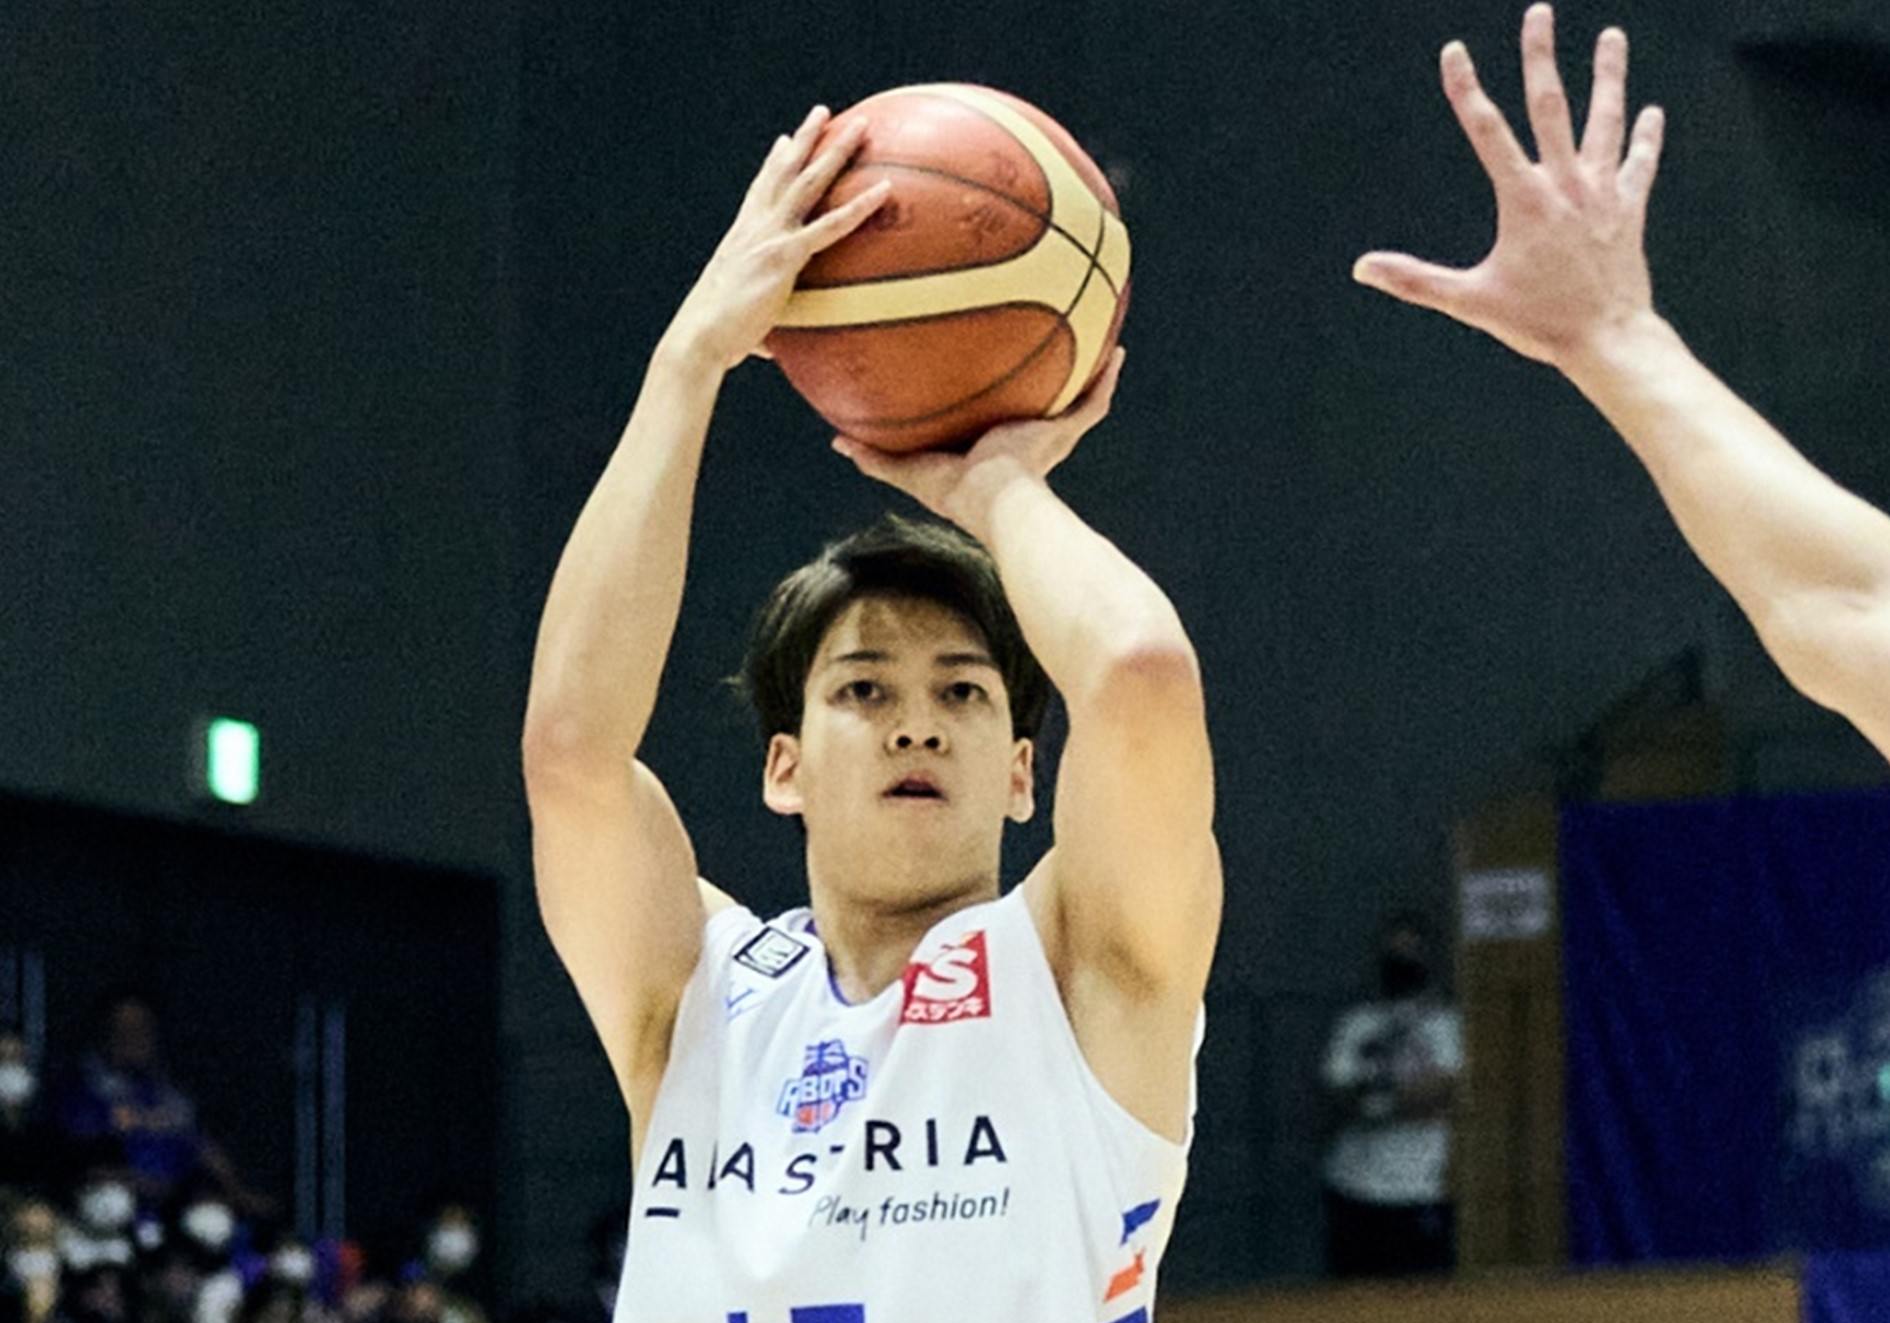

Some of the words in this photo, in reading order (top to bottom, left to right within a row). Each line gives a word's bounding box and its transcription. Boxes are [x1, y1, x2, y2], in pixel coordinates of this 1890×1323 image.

[651, 1115, 1008, 1195] AASRIA
[809, 1196, 870, 1242] Play
[879, 1187, 1011, 1226] fashion!
